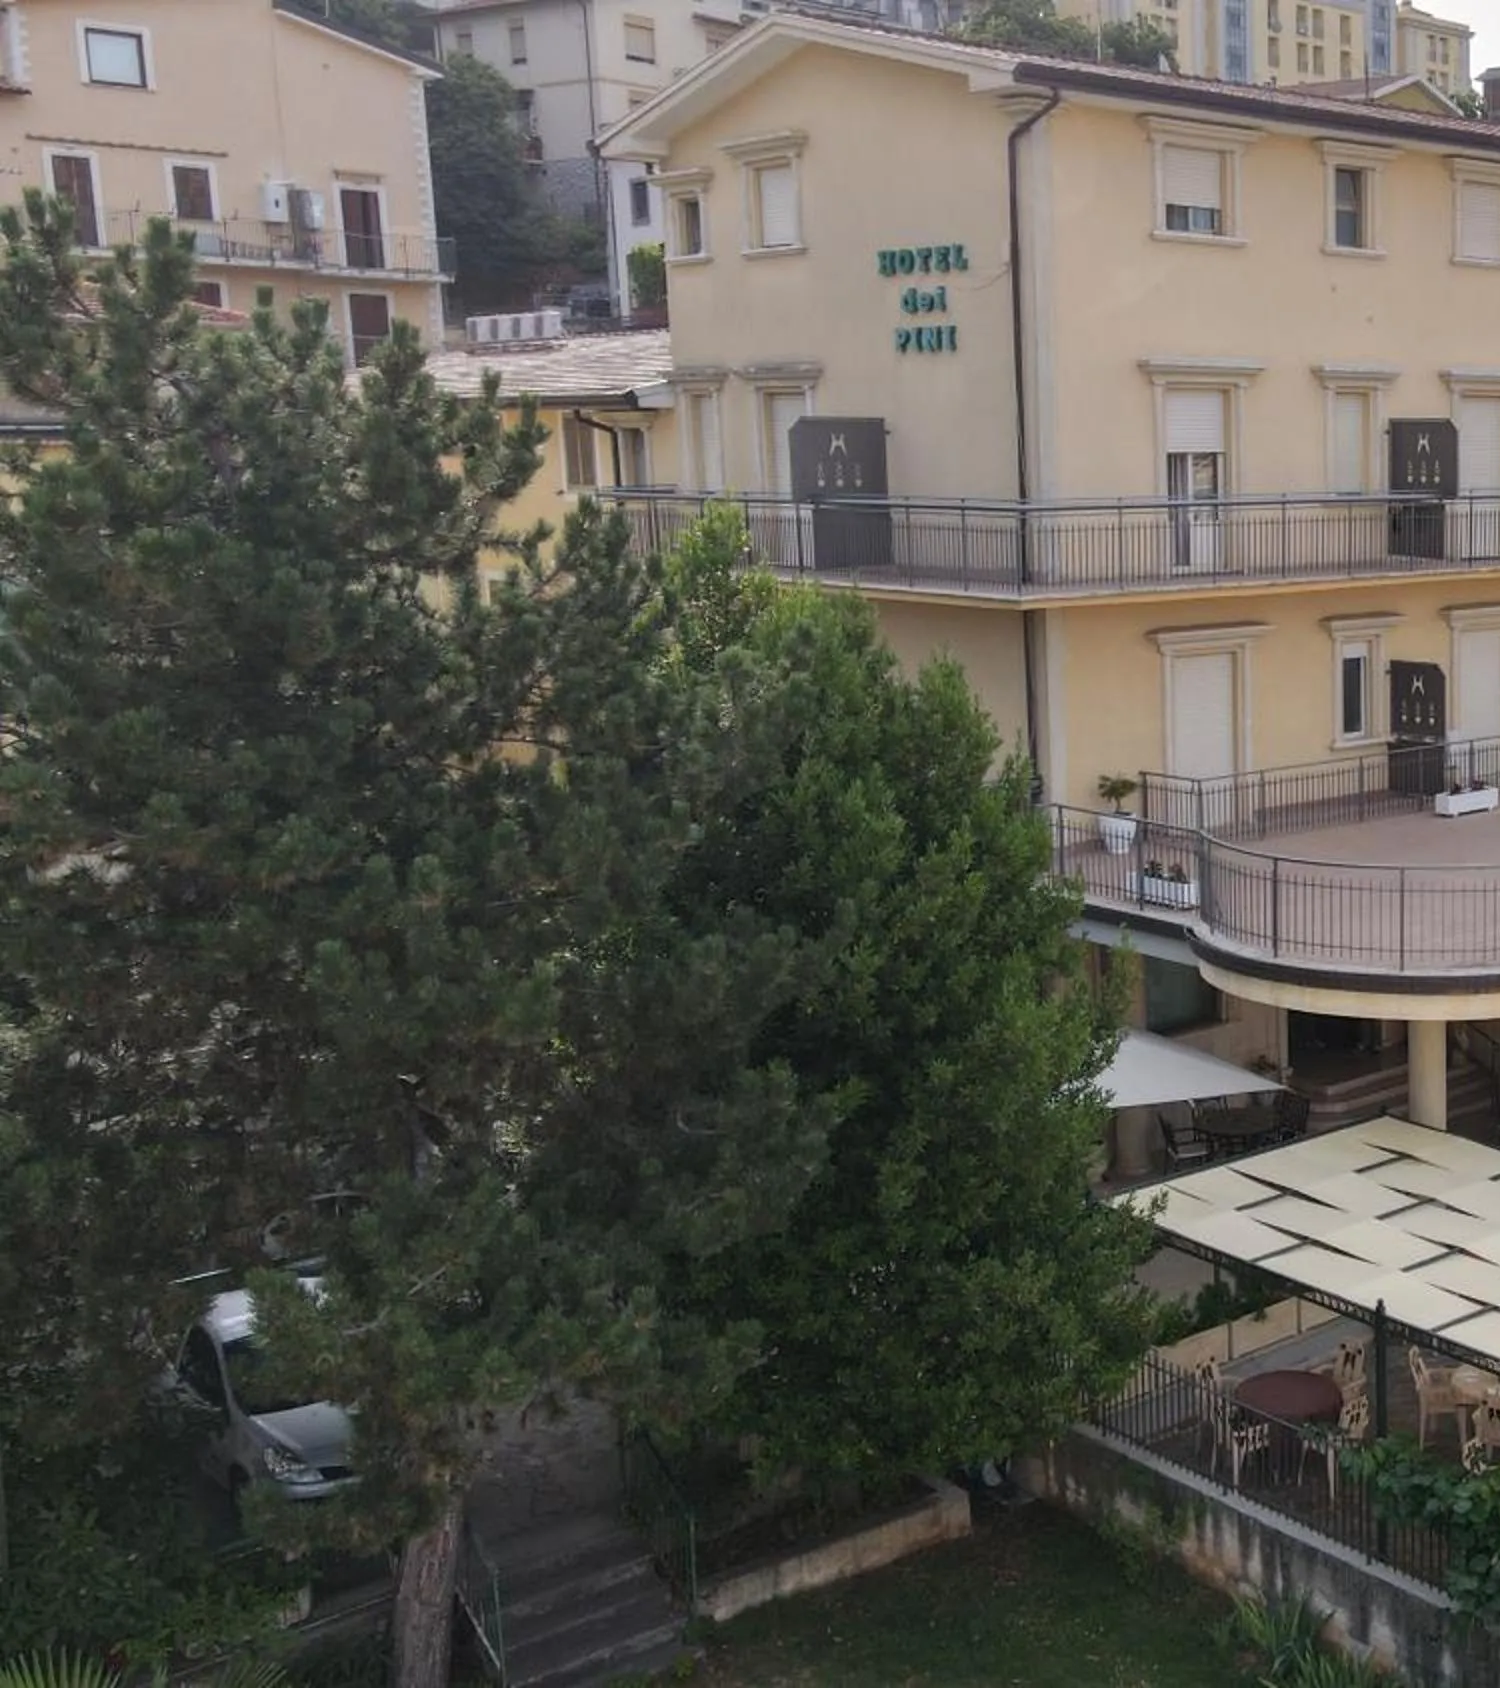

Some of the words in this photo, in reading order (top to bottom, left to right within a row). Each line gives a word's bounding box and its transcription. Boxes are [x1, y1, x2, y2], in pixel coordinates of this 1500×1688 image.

[877, 244, 968, 277] HOTEL
[902, 286, 947, 314] dei
[896, 325, 957, 353] PINI
